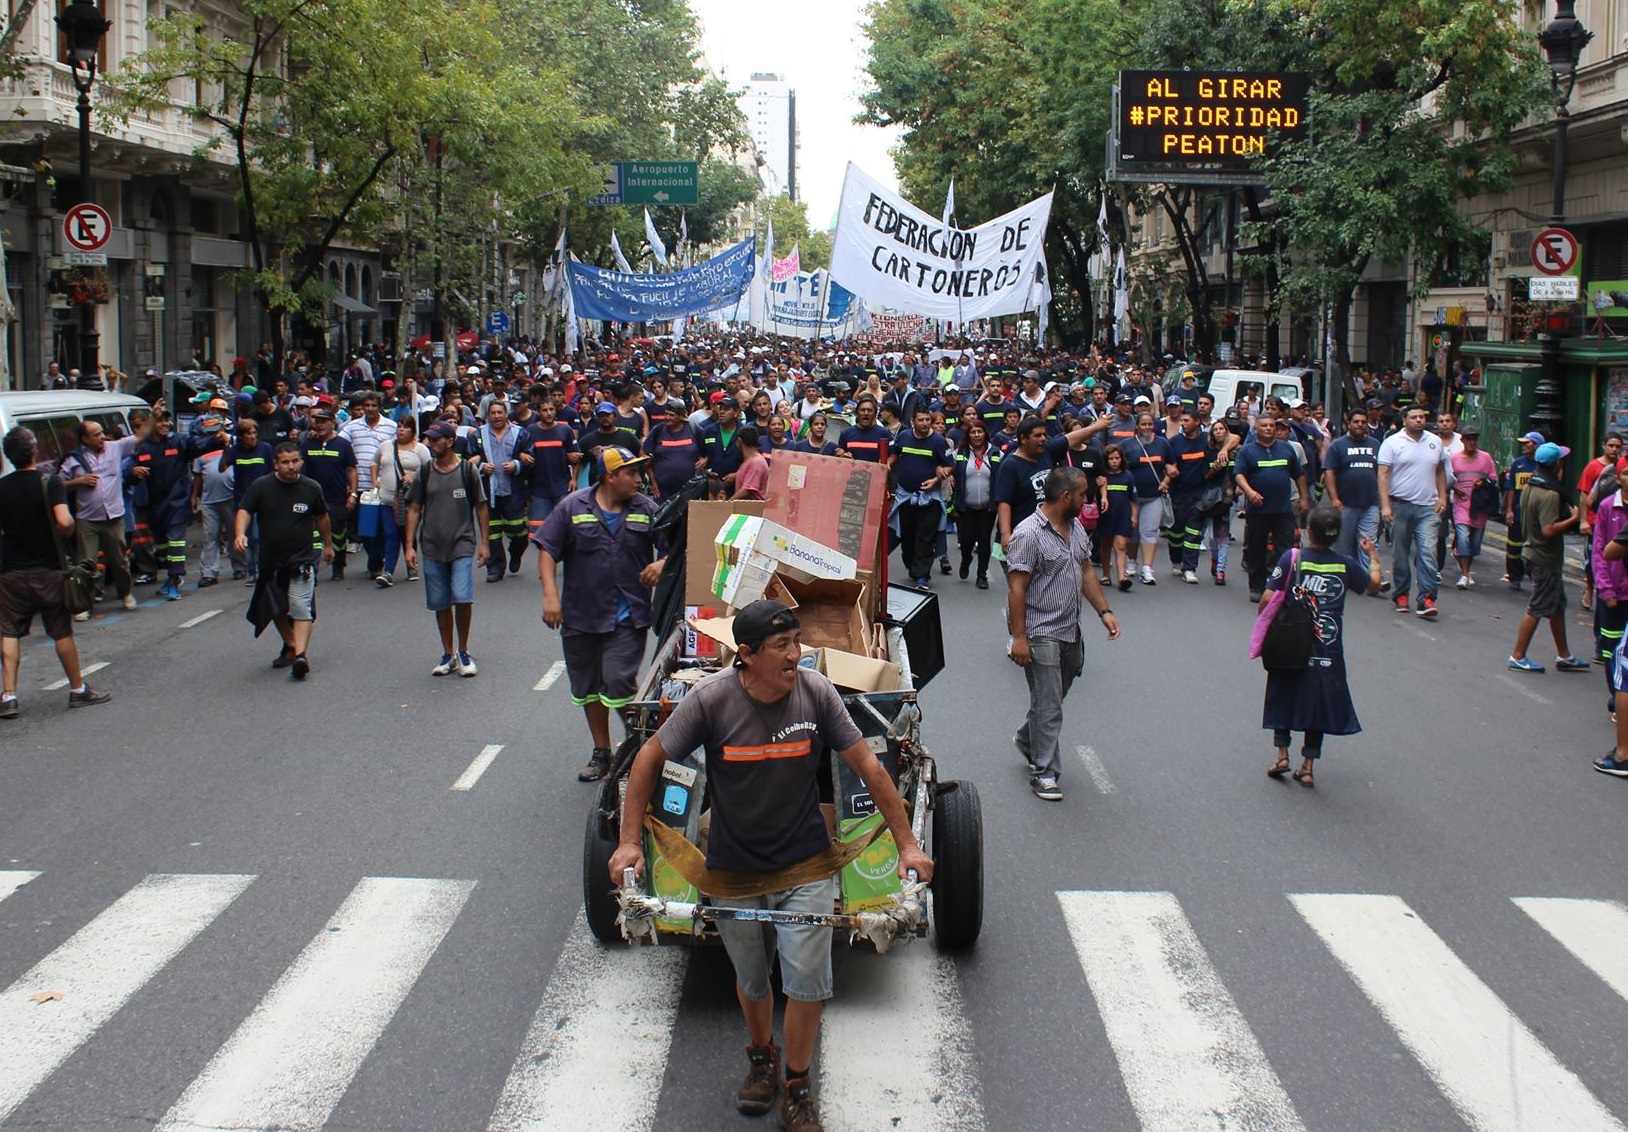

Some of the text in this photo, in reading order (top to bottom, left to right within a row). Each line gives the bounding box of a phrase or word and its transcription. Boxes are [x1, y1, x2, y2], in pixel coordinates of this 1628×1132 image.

[1147, 78, 1282, 99] AL GIRAR
[1129, 106, 1299, 127] #PRIORIDAD
[1163, 134, 1265, 154] PEATON
[632, 165, 689, 174] Aeropuerto
[628, 177, 693, 186] Internacional
[862, 192, 1031, 261] FEDERACION DE
[872, 245, 1022, 298] CARTONEROS
[1347, 447, 1374, 456] MTE
[1301, 574, 1330, 592] MTE
[688, 627, 696, 649] AGF
[664, 768, 682, 778] nobel
[870, 857, 895, 875] VERDE
